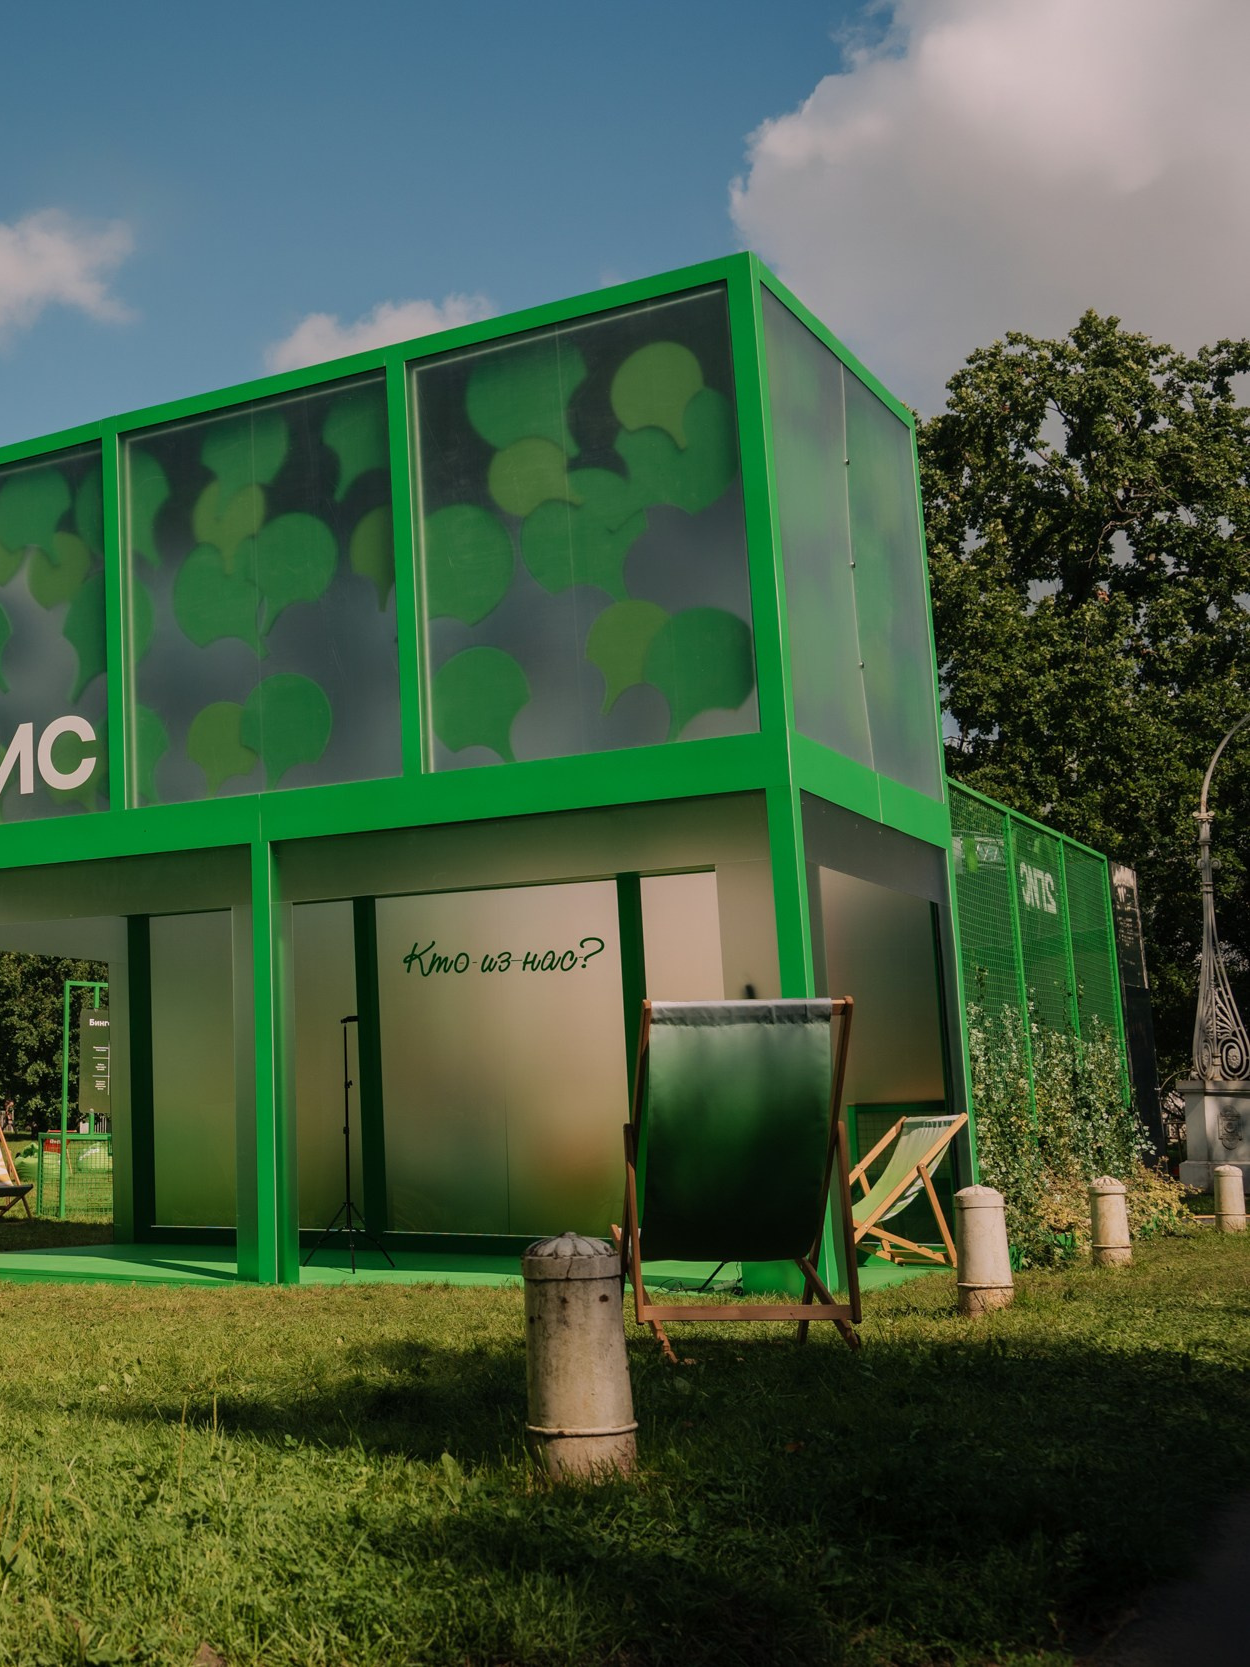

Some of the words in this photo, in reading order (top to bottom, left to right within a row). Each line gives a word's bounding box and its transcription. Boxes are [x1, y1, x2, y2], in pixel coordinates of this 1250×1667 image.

[403, 940, 470, 977] Кто
[480, 951, 512, 973] из
[522, 937, 605, 972] нас?
